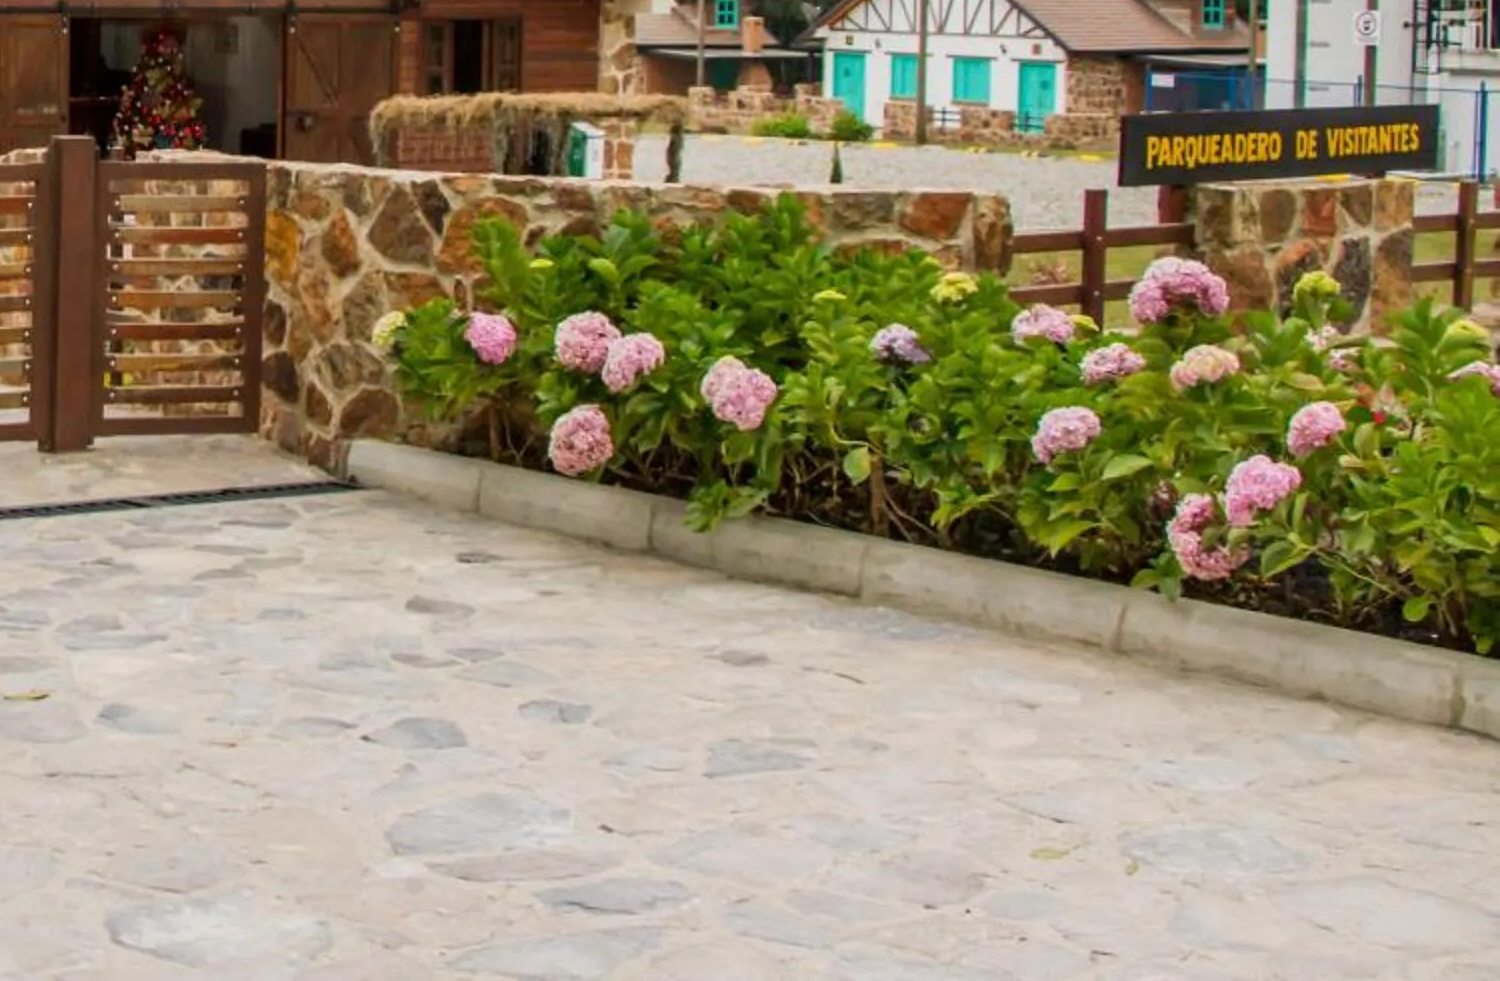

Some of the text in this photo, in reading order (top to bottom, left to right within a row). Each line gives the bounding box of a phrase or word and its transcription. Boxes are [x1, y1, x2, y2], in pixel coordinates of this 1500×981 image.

[1145, 122, 1420, 169] PARQUEADERO DE VISITANTES
